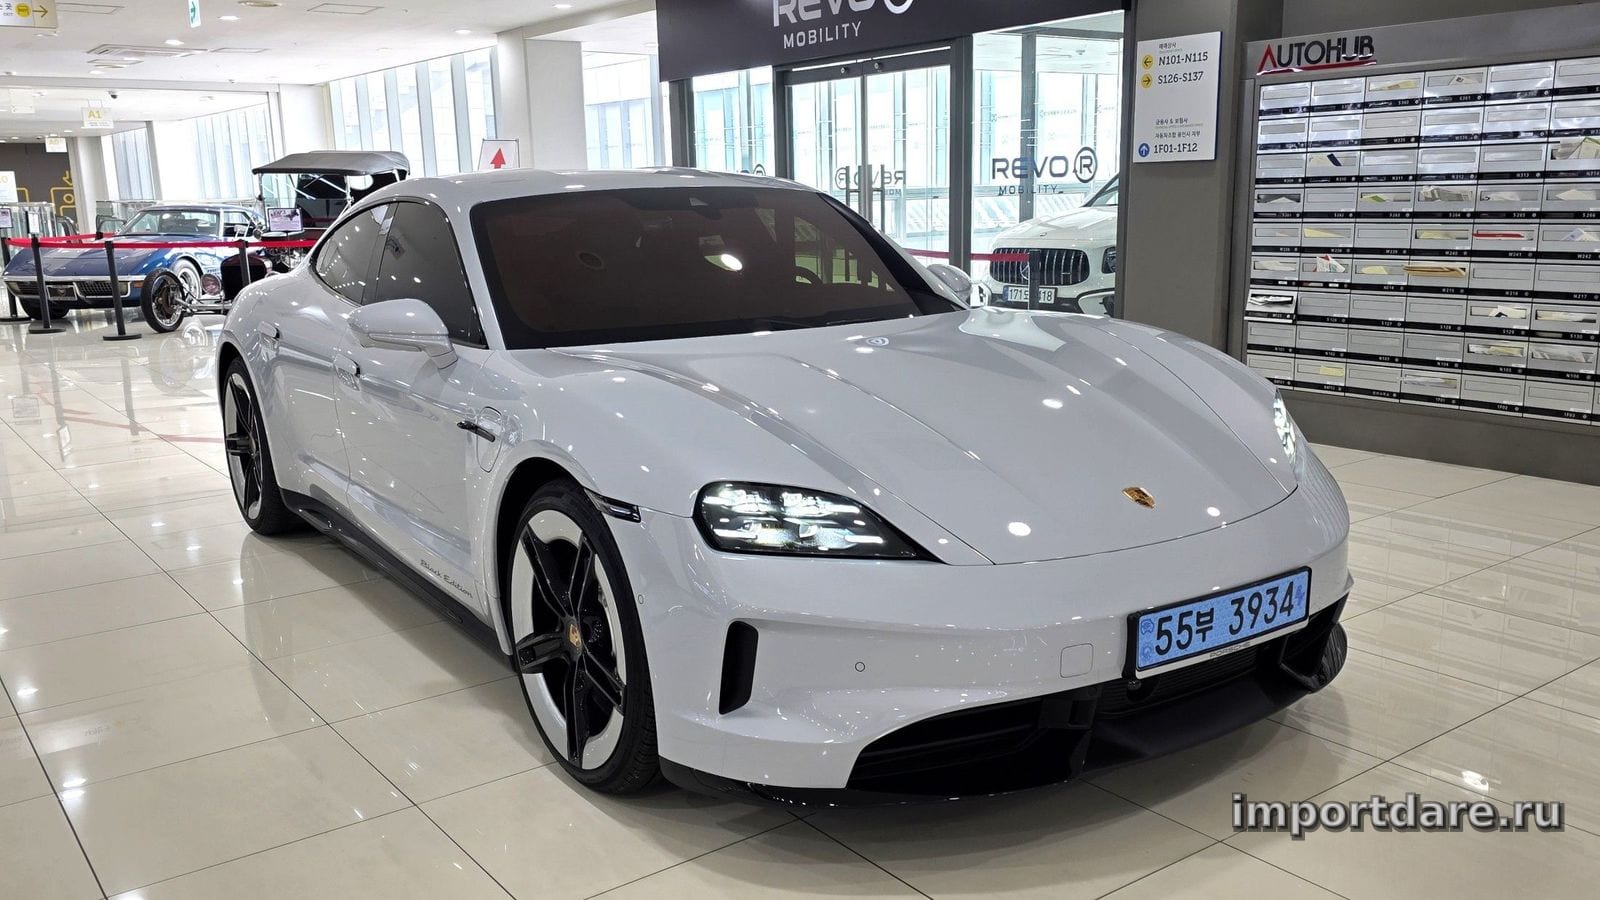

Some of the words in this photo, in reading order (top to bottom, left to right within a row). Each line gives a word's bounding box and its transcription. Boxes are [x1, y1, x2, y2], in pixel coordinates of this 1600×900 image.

[784, 21, 862, 49] MOBILITY
[1158, 51, 1209, 66] N101-N115
[1258, 35, 1375, 72] AUTOHUB
[1157, 71, 1204, 85] S126-S137
[1154, 142, 1198, 154] 1F01-1F12
[992, 156, 1068, 179] REVO
[998, 184, 1059, 195] MOBILITY
[443, 574, 474, 599] Edition
[1154, 607, 1215, 656] 55부
[1228, 580, 1295, 636] 3934
